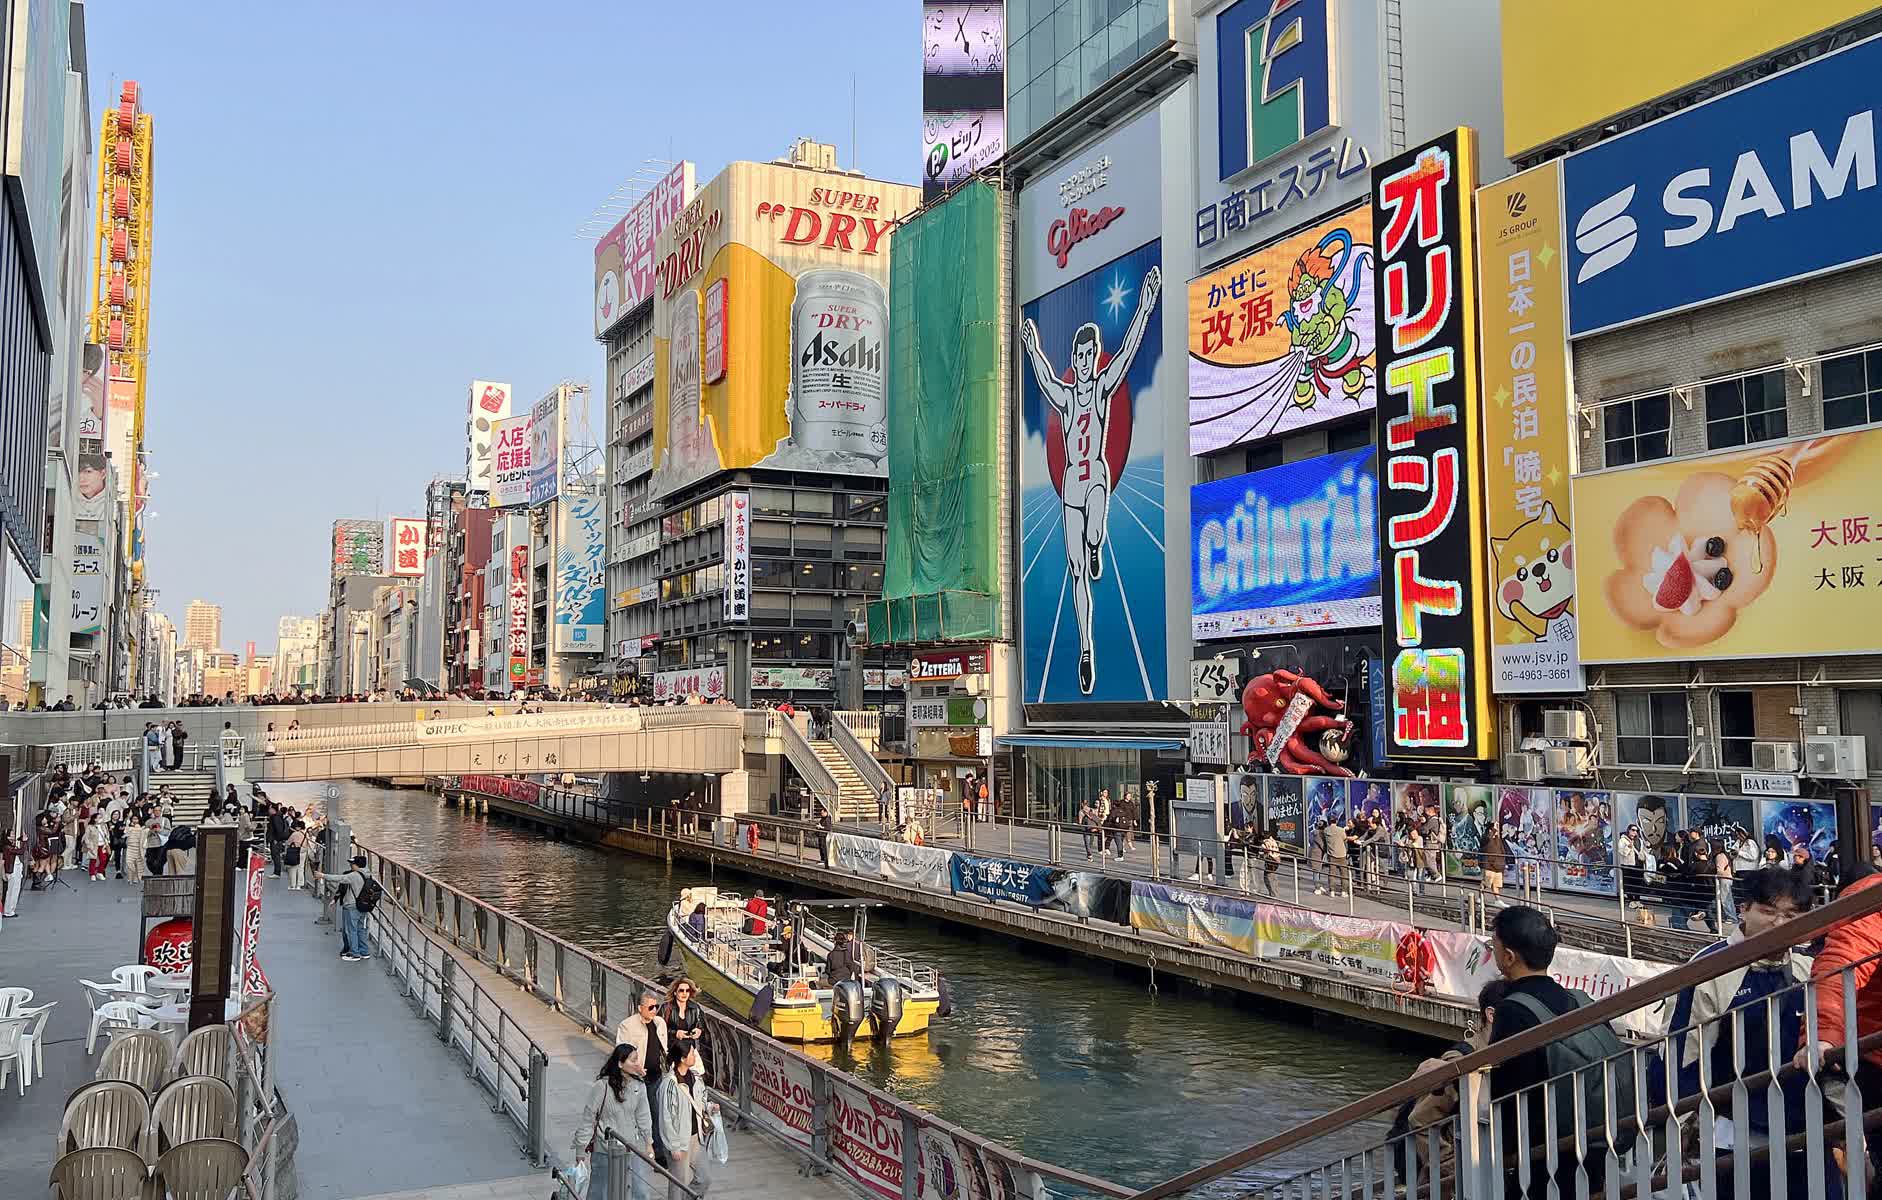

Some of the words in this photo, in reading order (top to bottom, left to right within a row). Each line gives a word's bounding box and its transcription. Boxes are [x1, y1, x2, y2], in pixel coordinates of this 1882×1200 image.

[951, 115, 984, 161] ピップ
[979, 137, 1001, 161] 2025
[810, 186, 881, 213] SUPER
[1197, 136, 1372, 249] 日商エステム
[624, 167, 684, 265] 家事代行
[673, 200, 704, 241] SUPER
[1498, 228, 1508, 239] JS
[1510, 217, 1538, 235] GROUP
[1047, 204, 1127, 269] Glico
[1207, 267, 1267, 309] かぜに
[827, 304, 858, 314] SUPER
[1201, 293, 1276, 357] 改源
[801, 330, 881, 374] Asahi
[832, 372, 852, 389] 生
[818, 400, 866, 412] スーパードライ
[1076, 407, 1093, 483] グリコ
[496, 470, 531, 484] プレゼント
[735, 514, 746, 554] 本場の味
[1810, 516, 1882, 549] 大阪
[733, 558, 746, 616] かに道楽
[508, 577, 529, 654] 大阪王将
[921, 661, 963, 677] ZETTERIA
[1502, 650, 1569, 666] www.jsv.jp
[1199, 664, 1230, 697] くくる
[1501, 668, 1571, 682] 06-4963-3661
[473, 752, 558, 767] えびす橋
[1743, 778, 1770, 790] BAR
[976, 860, 1031, 890] 近畿大学
